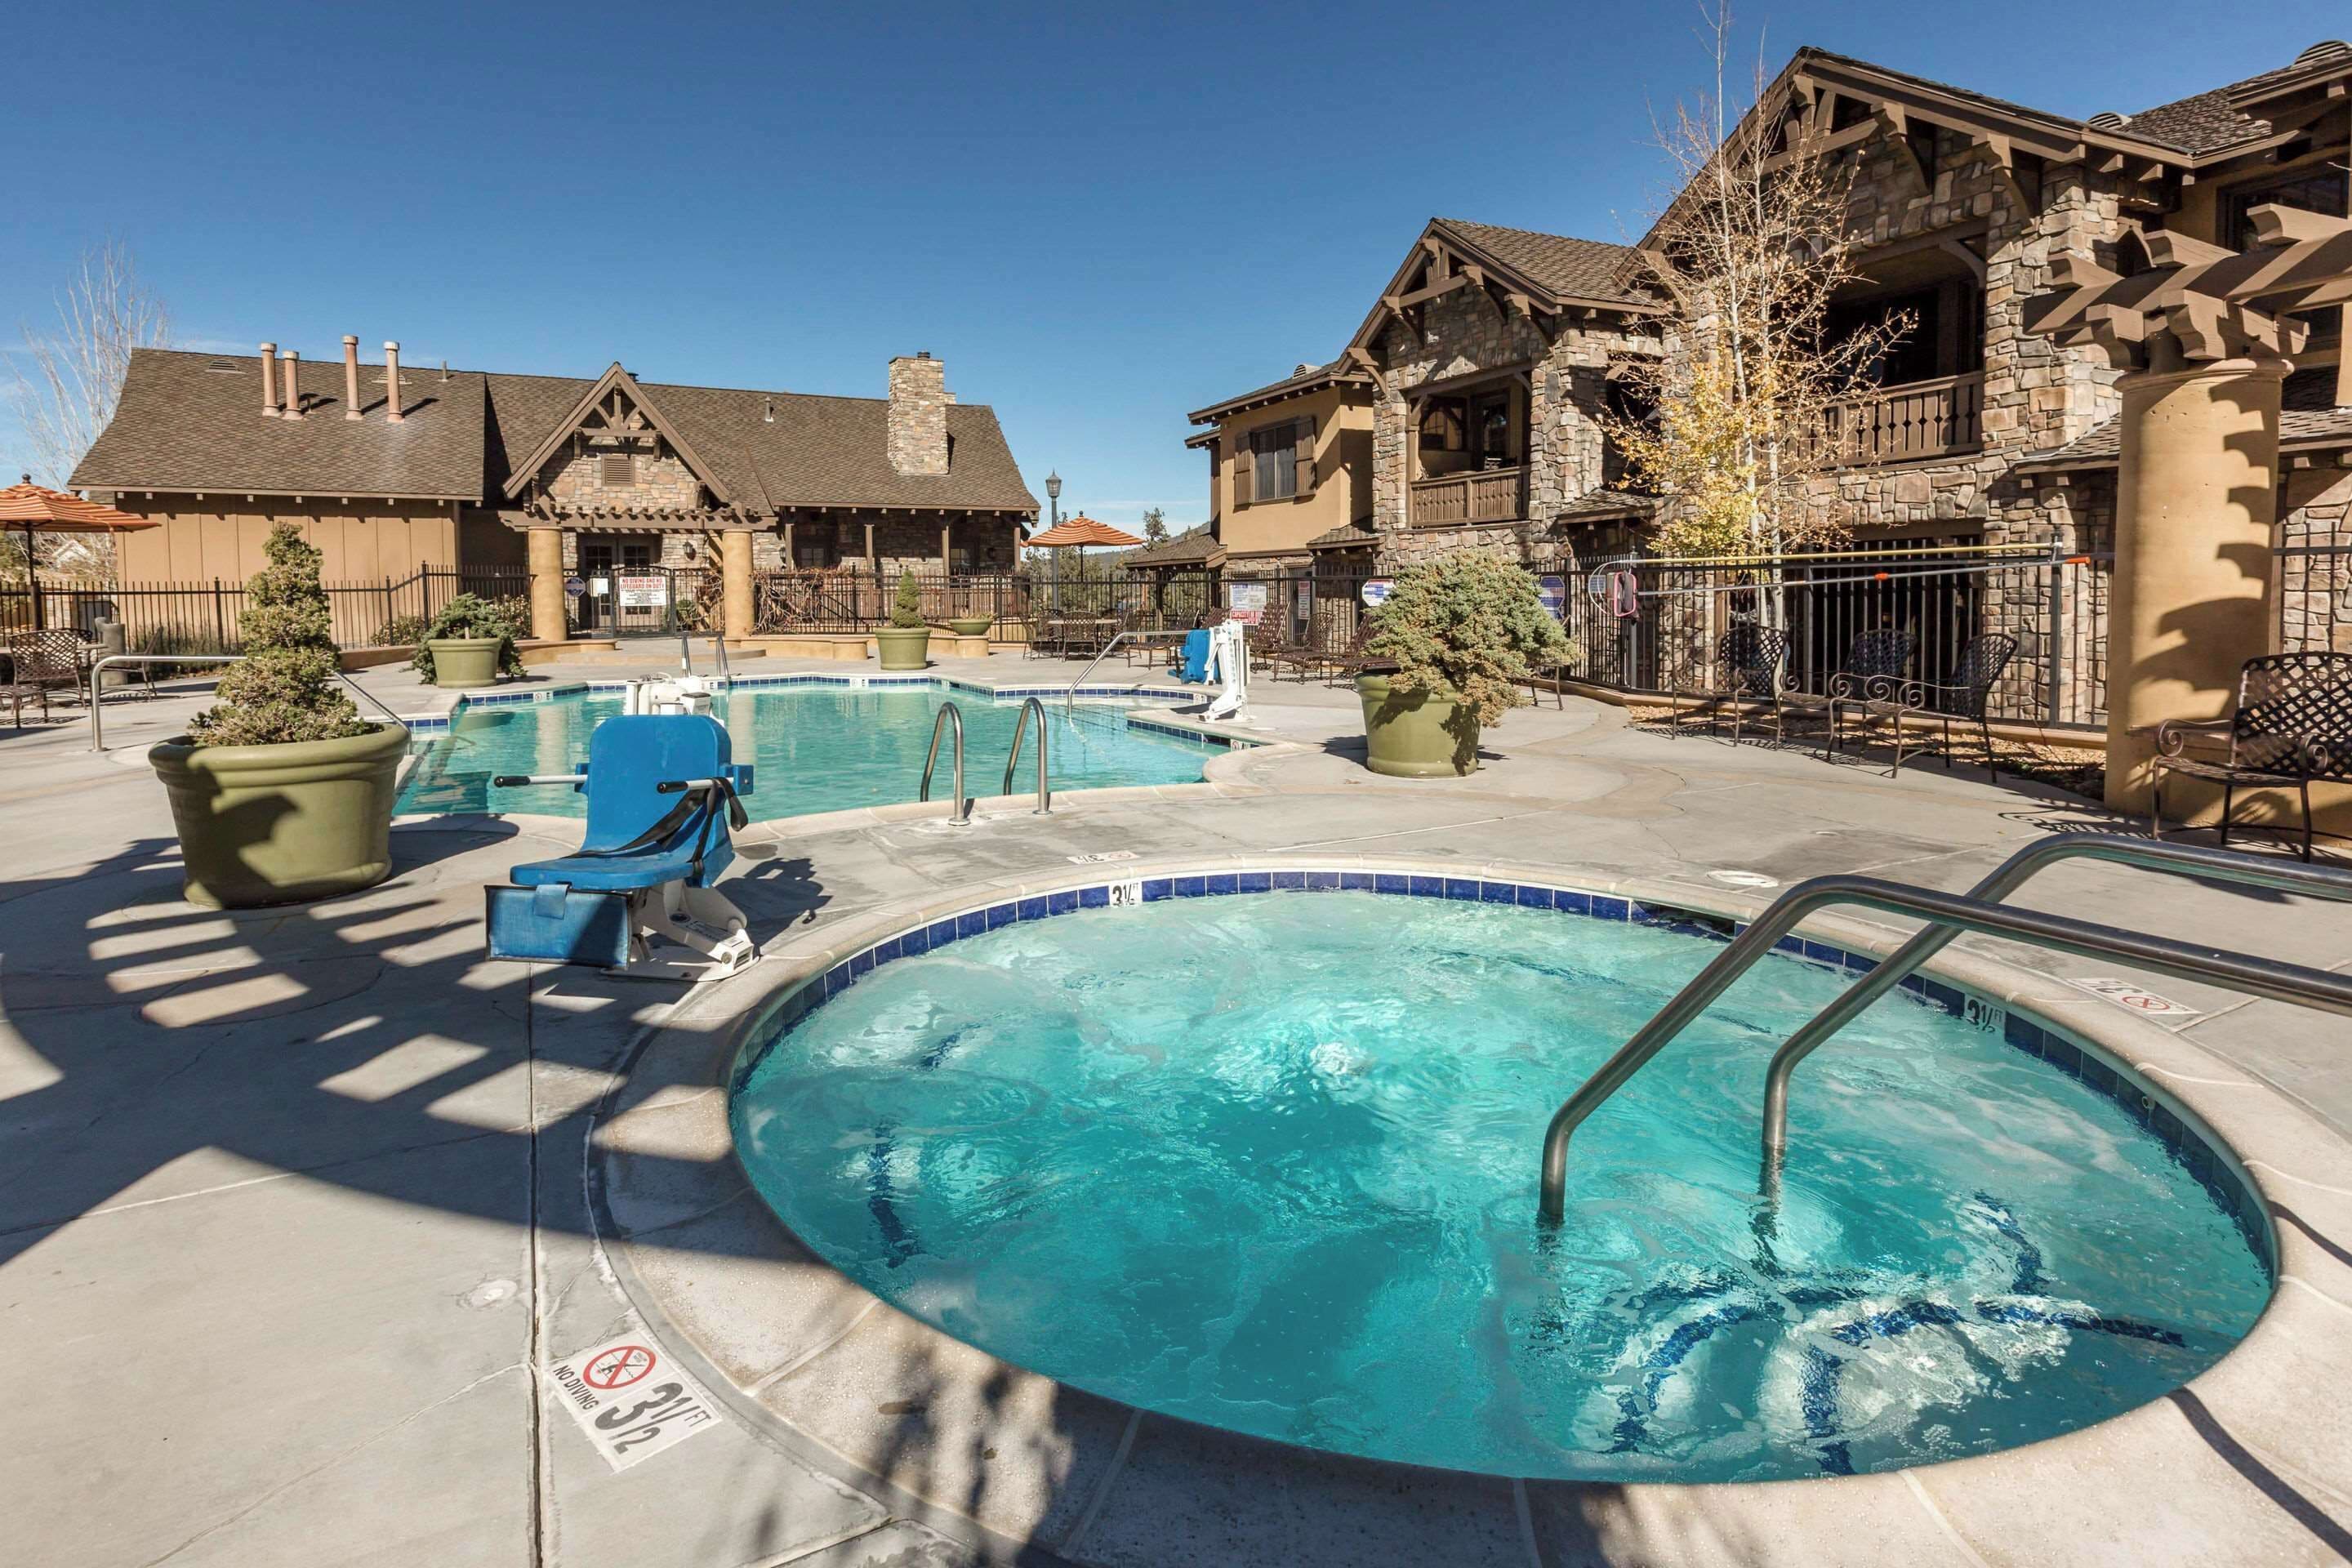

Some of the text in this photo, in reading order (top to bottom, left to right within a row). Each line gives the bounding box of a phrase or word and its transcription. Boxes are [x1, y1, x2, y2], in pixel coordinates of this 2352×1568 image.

[553, 1365, 599, 1410] NO DIVING
[684, 1410, 711, 1428] FT
